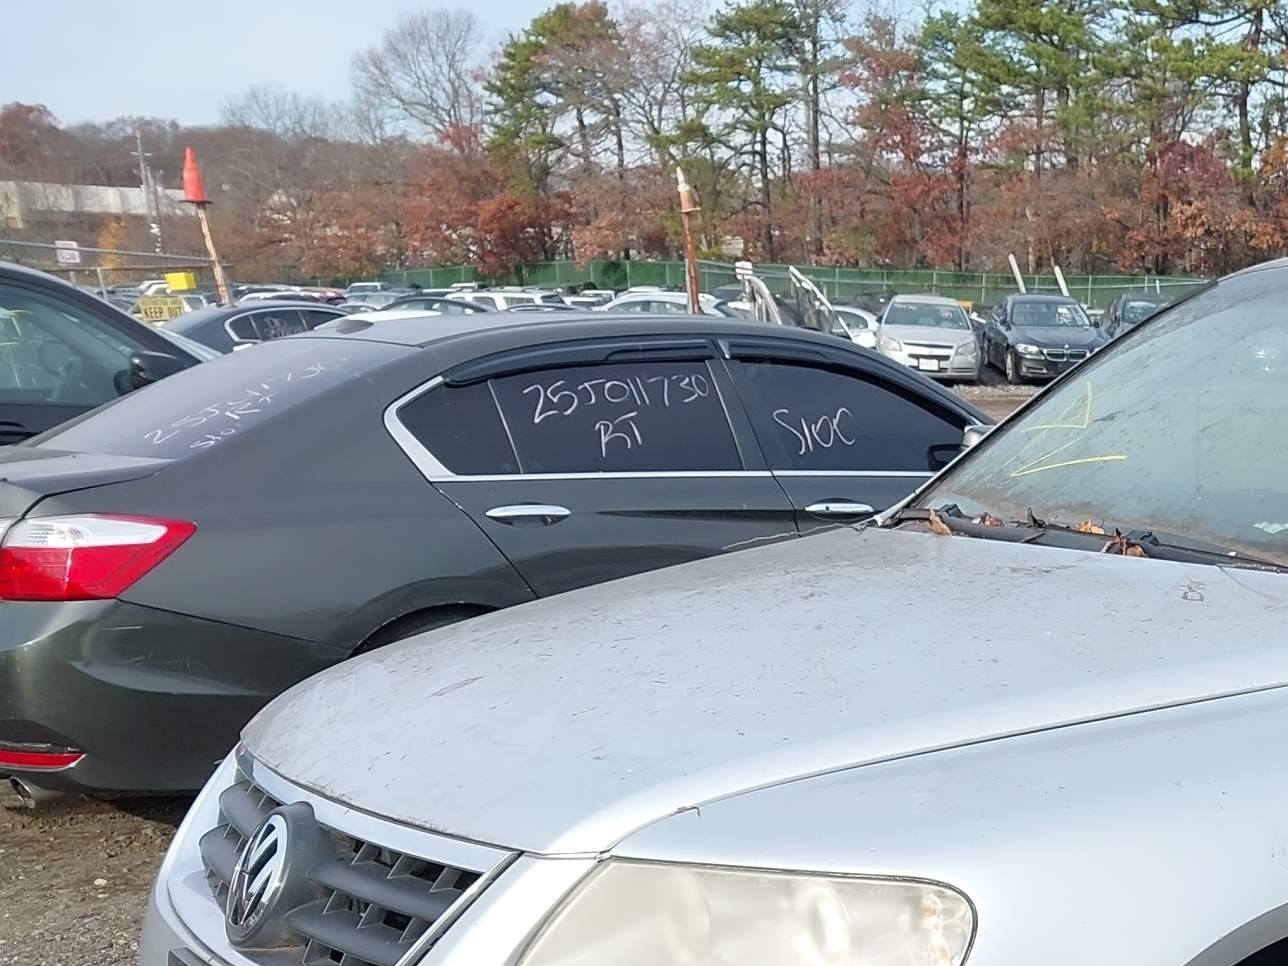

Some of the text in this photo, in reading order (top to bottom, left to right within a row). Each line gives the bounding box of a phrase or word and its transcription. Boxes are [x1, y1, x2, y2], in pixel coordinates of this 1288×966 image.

[143, 306, 164, 319] KEEP
[523, 373, 709, 424] 25J011730
[594, 411, 643, 458] RT
